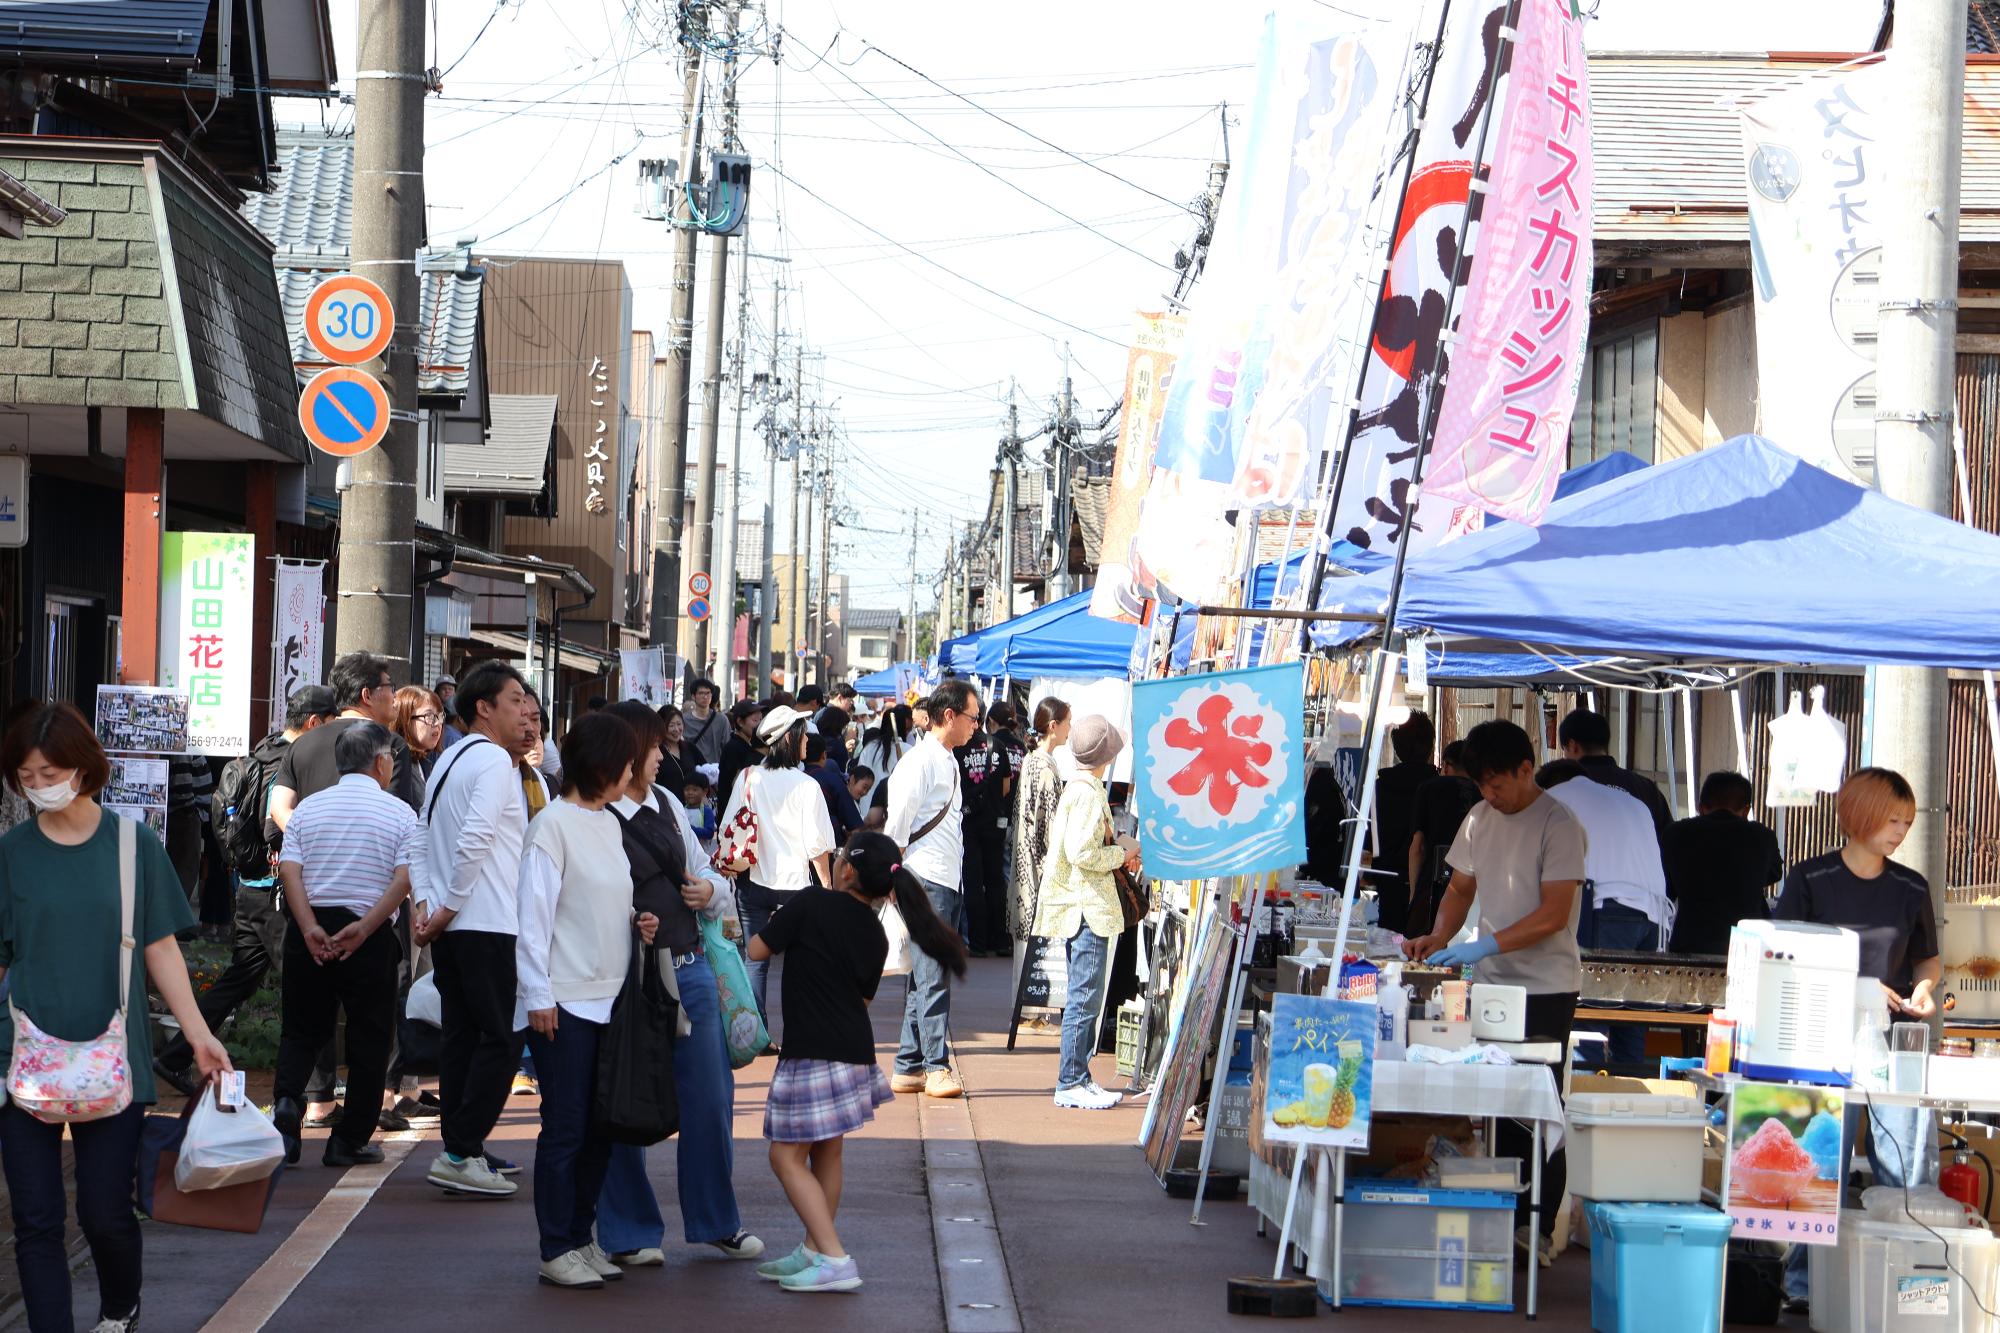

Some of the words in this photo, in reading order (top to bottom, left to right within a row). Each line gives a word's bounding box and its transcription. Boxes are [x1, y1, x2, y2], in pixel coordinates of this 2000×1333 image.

[325, 301, 375, 340] 30
[693, 579, 707, 590] 30
[189, 557, 224, 706] 山田花店
[1164, 694, 1273, 816] 氷
[1291, 1029, 1351, 1054] パイン
[1787, 1221, 1836, 1234] ¥300
